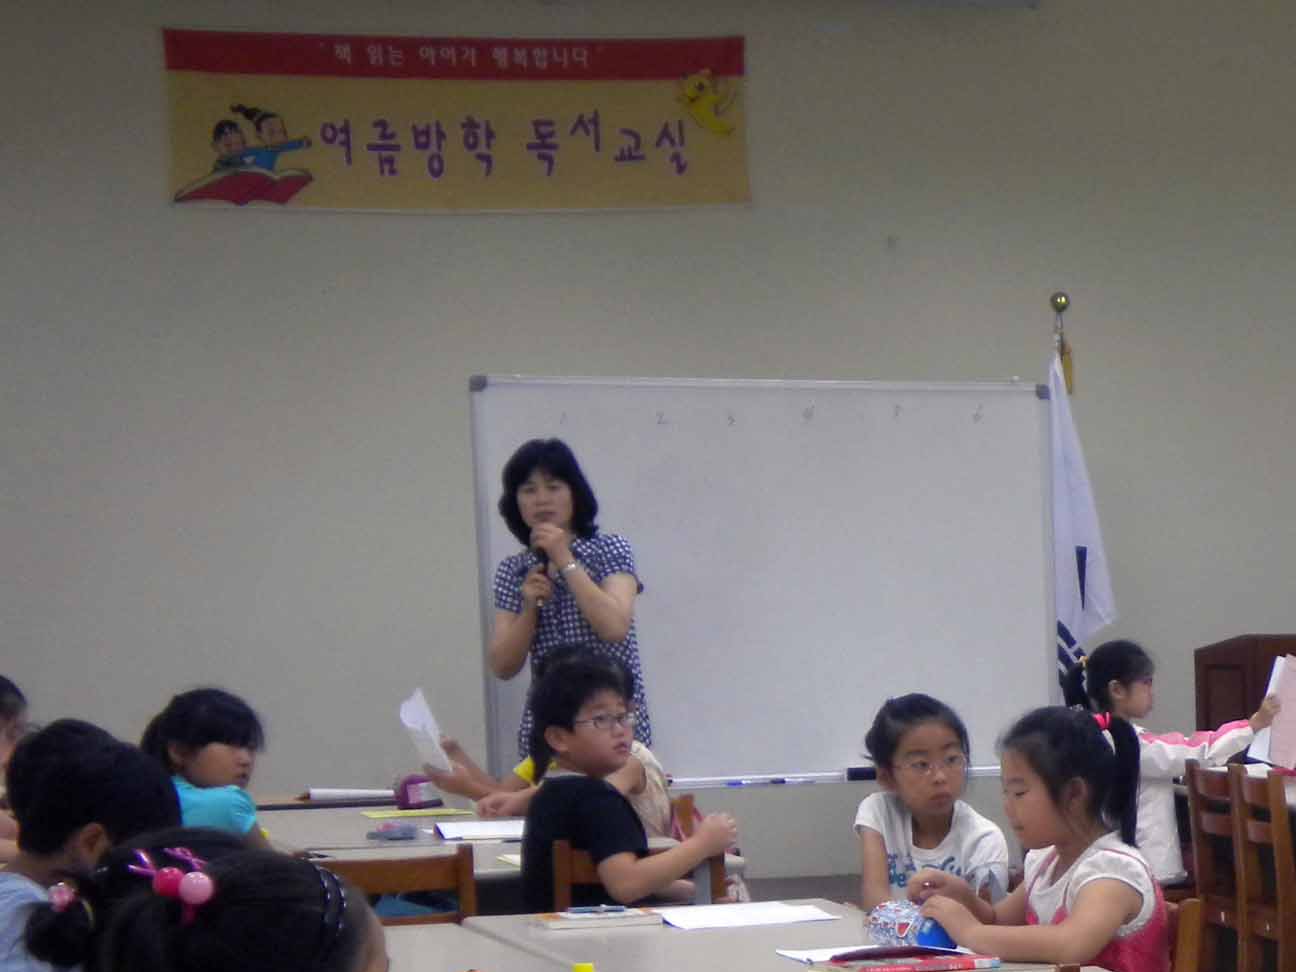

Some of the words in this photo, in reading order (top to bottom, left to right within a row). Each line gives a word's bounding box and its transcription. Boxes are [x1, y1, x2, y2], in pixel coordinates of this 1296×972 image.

[334, 42, 353, 65] 책
[366, 44, 404, 67] 읽는
[419, 45, 478, 69] 아이가
[491, 46, 591, 71] 행복합니다
[319, 113, 496, 178] 여름방학
[525, 108, 689, 177] 독서교실
